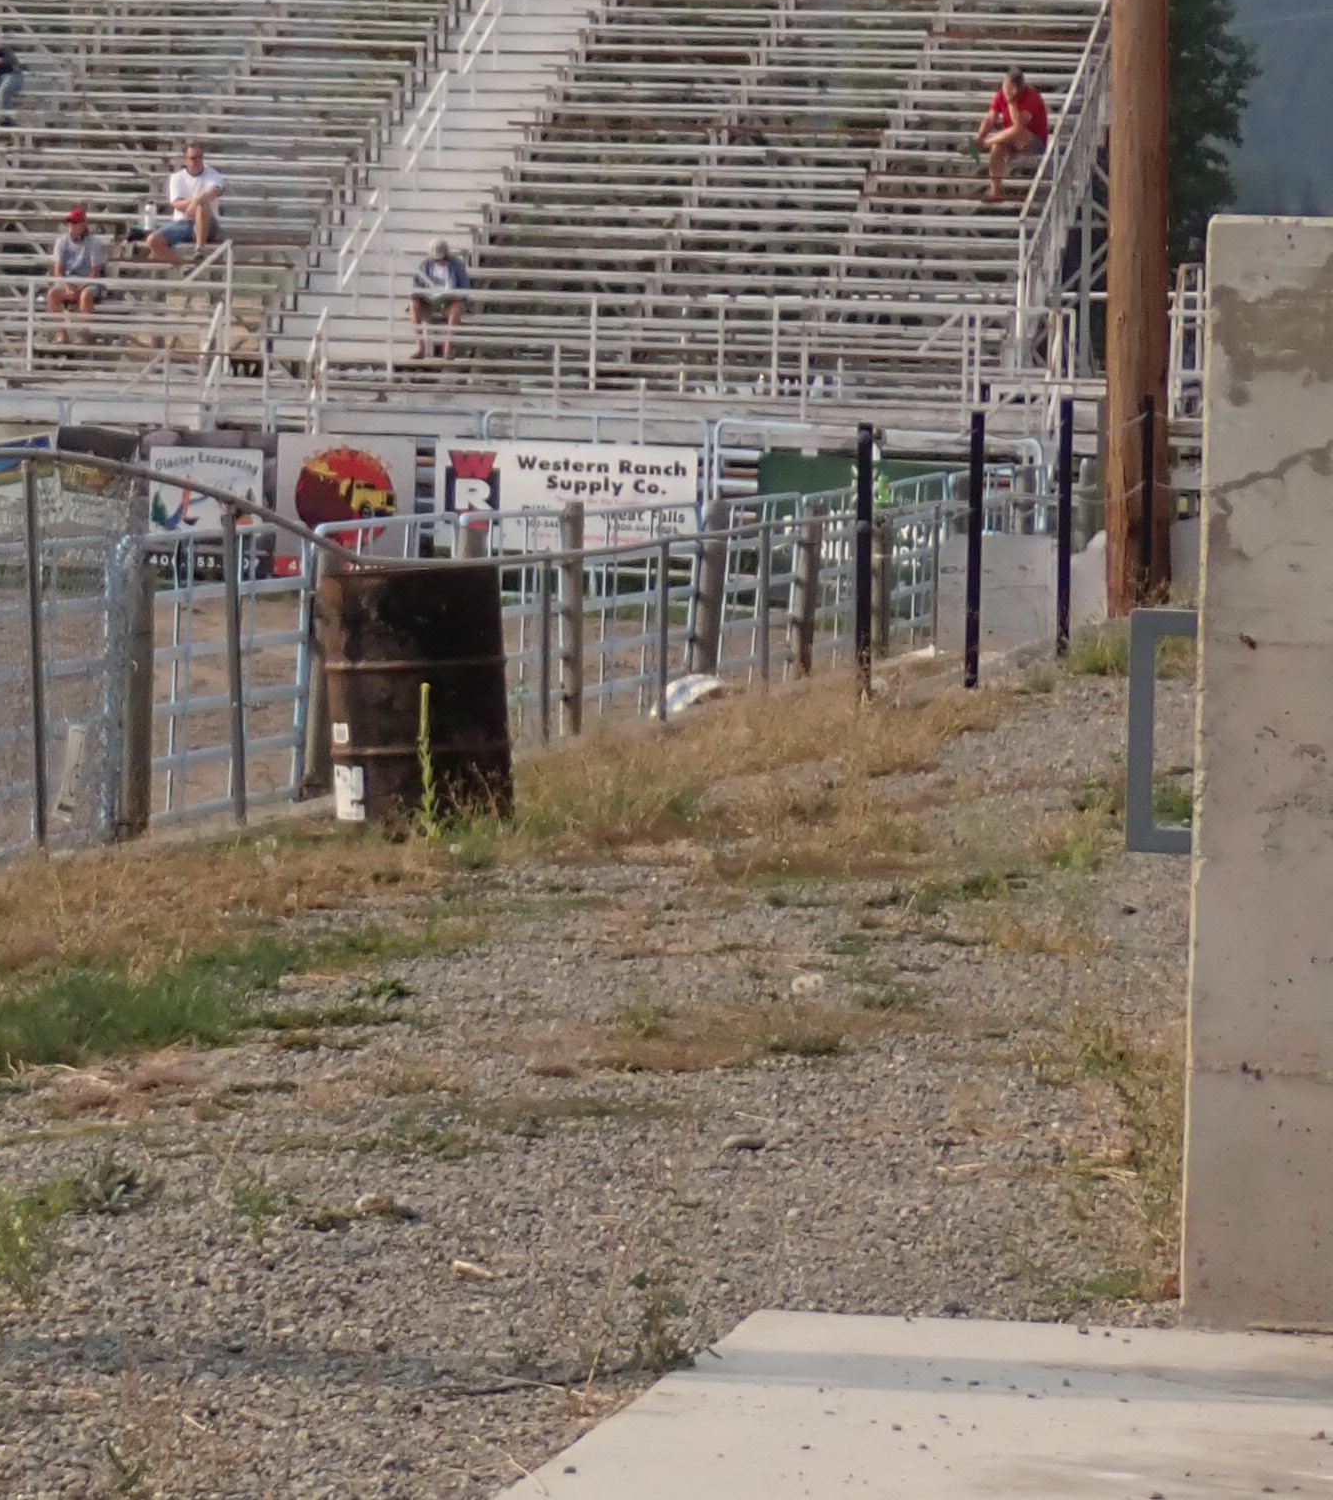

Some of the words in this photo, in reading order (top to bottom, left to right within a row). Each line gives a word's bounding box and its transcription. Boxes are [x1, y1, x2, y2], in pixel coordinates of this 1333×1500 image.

[517, 455, 610, 474] Western
[619, 459, 687, 477] Ranch
[454, 477, 492, 511] R
[546, 474, 624, 496] Supply
[632, 480, 667, 495] Co.
